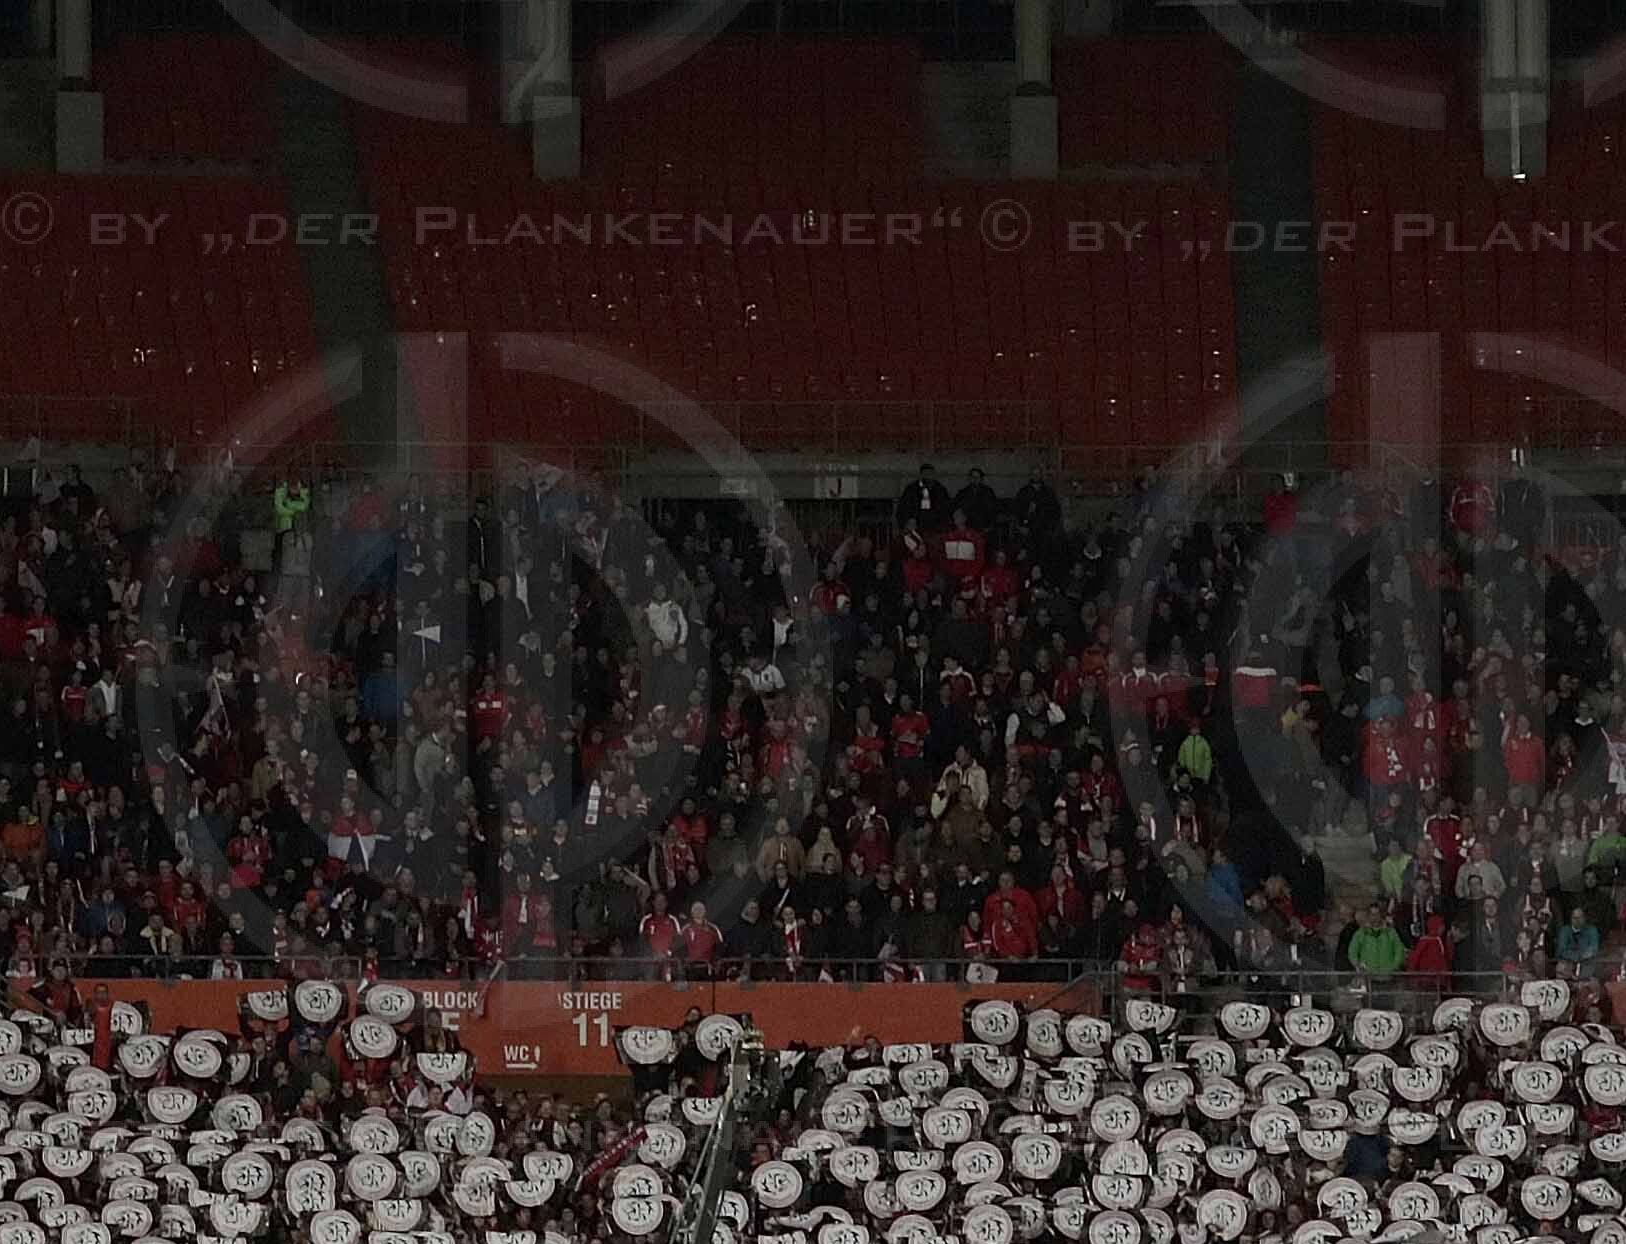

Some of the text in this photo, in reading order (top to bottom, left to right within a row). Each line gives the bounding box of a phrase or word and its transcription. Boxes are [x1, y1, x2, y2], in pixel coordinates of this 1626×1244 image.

[424, 992, 478, 1008] BLOCK
[563, 992, 622, 1010] STIEGE
[572, 1012, 609, 1047] 11
[504, 1046, 529, 1062] WC
